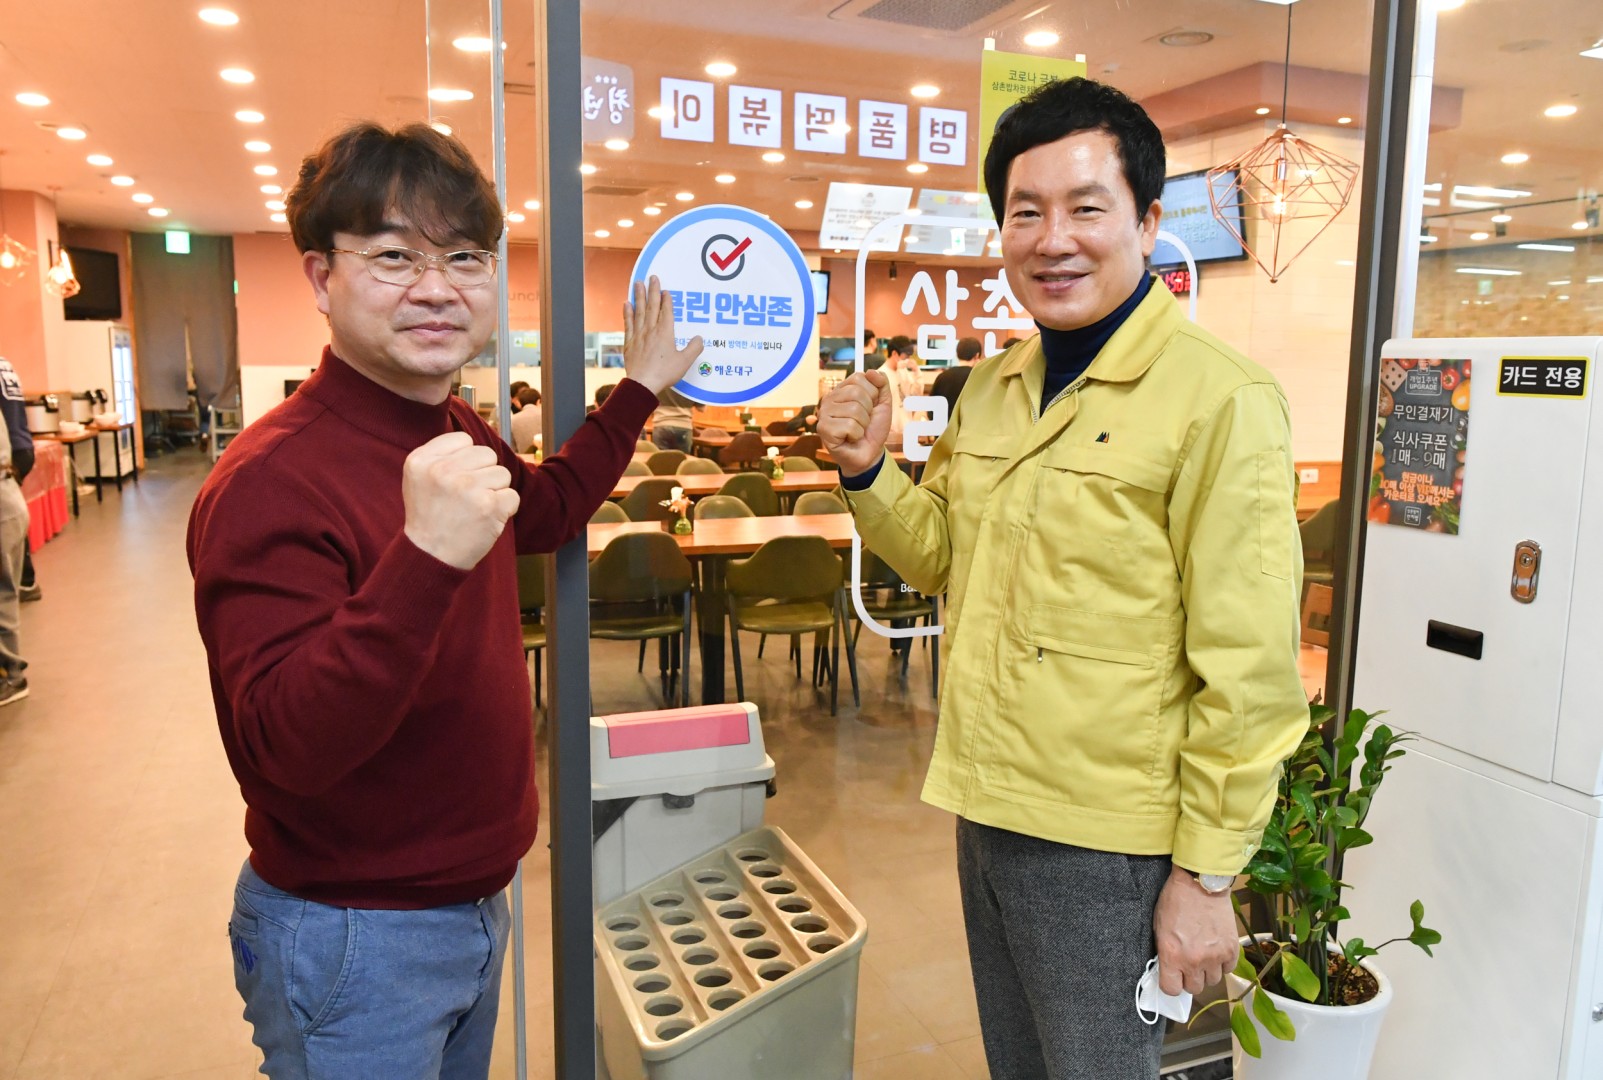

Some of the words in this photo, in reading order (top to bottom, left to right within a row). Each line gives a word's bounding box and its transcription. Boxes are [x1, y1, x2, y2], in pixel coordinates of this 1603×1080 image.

[1008, 69, 1037, 84] 코로나
[715, 292, 793, 328] 안심존
[728, 339, 748, 349] 방역한
[750, 341, 783, 351] 시설입니다
[714, 365, 753, 376] 해운대구
[1502, 366, 1538, 386] 카드
[1545, 367, 1582, 388] 전용
[1393, 404, 1454, 423] 무인결재기
[1392, 430, 1448, 452] 식사쿠폰
